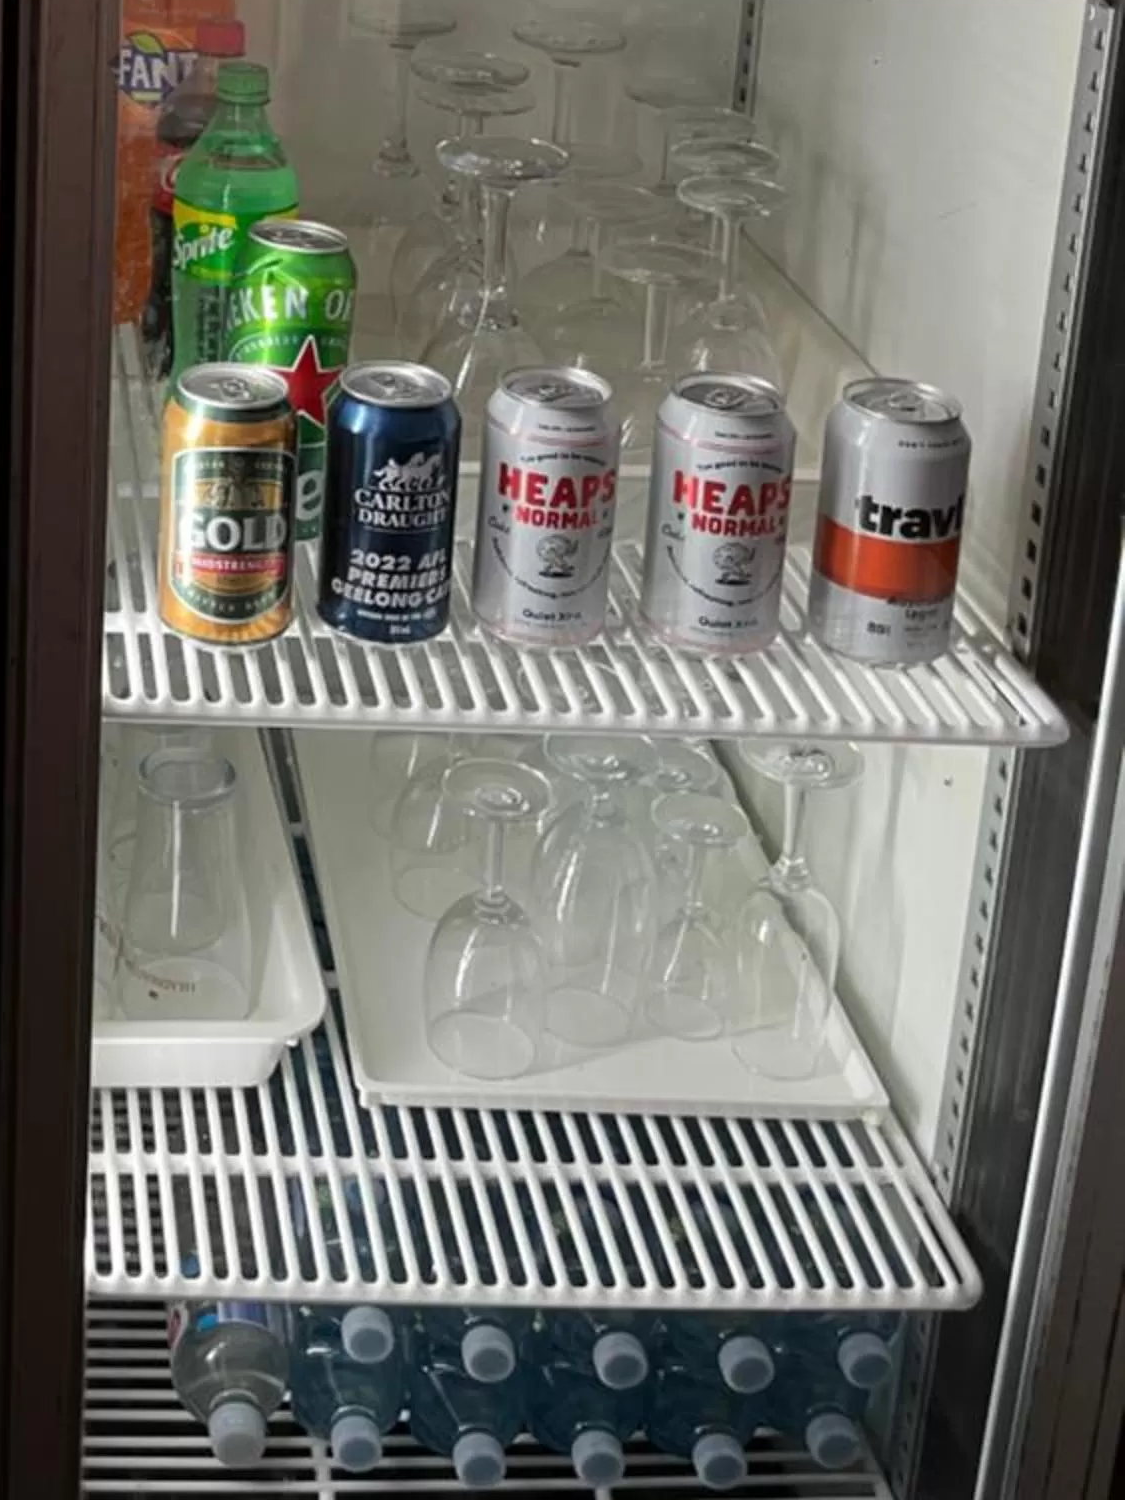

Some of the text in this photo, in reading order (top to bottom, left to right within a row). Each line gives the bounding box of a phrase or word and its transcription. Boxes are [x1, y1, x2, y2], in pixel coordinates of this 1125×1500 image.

[118, 49, 200, 89] FANT
[173, 224, 235, 271] Sprite
[354, 487, 452, 512] CARLTON
[497, 462, 617, 509] HEAPS
[672, 469, 793, 516] HEAPS
[179, 512, 289, 551] GOLD
[357, 506, 449, 528] DRAUGHT
[690, 512, 776, 537] NORMAL
[349, 548, 412, 571] 2022
[331, 576, 423, 609] GEELONG
